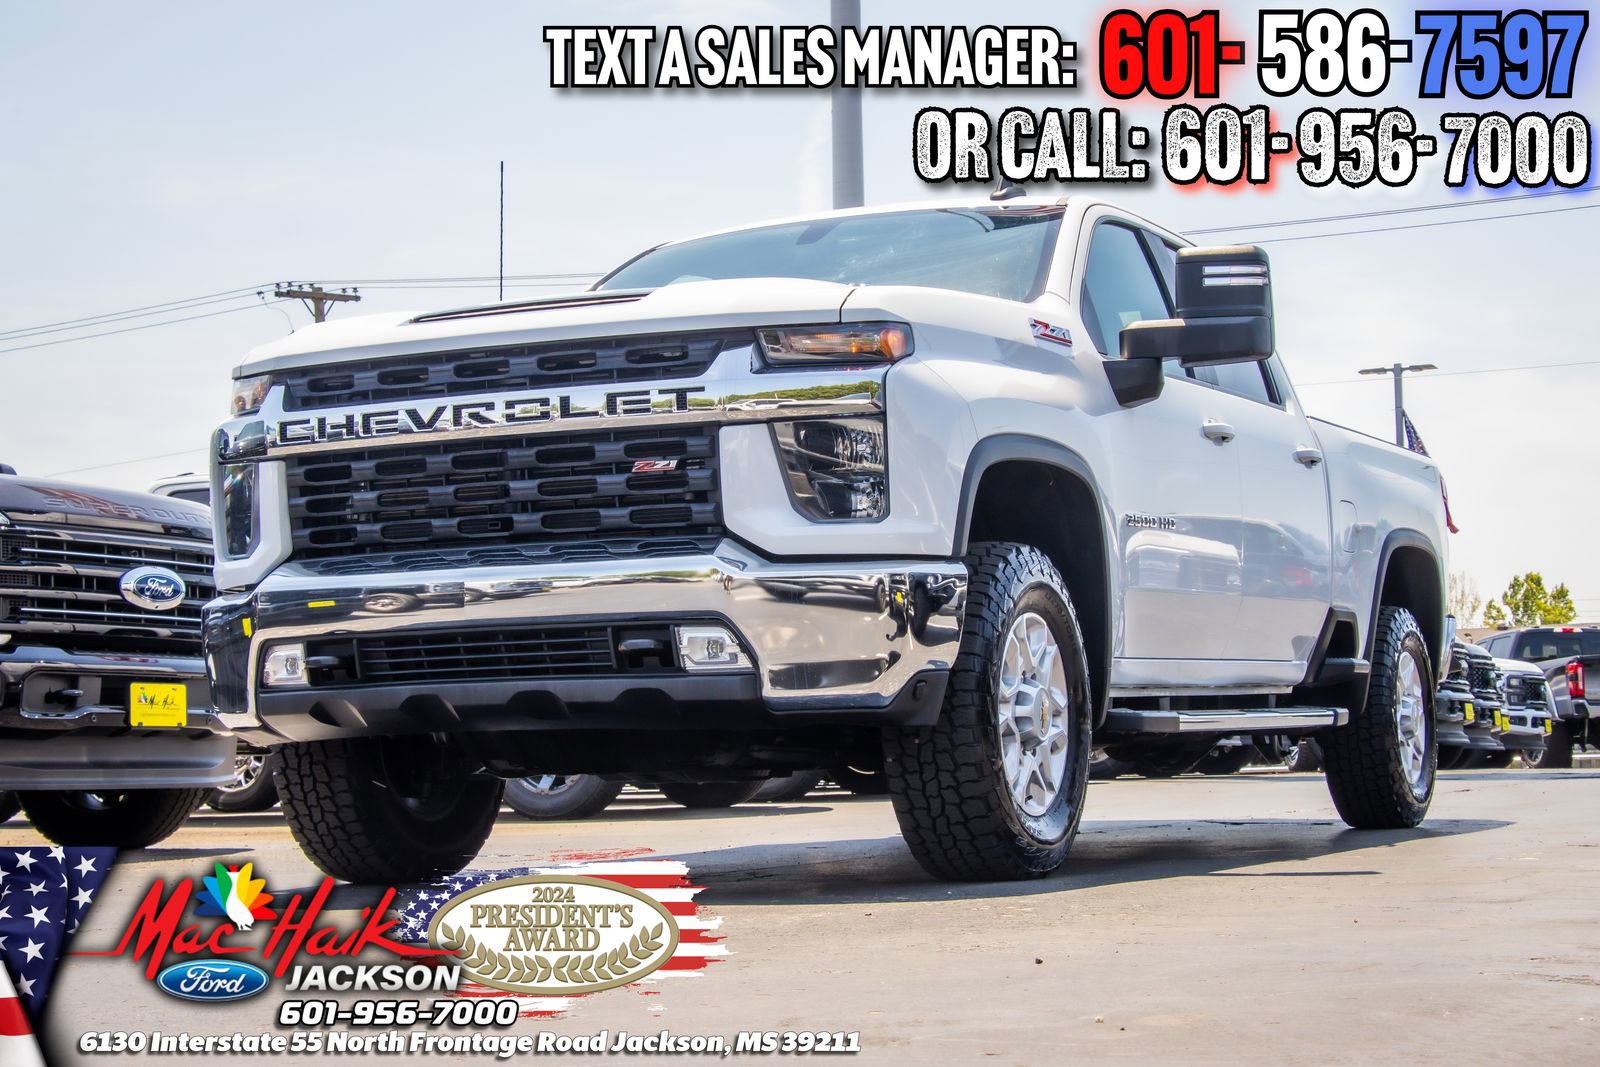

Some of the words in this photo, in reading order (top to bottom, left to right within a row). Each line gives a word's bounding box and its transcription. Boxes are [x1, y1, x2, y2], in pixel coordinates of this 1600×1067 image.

[277, 386, 706, 445] CHEVROLET
[44, 496, 149, 521] SUPER
[1125, 513, 1157, 528] 2500
[1158, 516, 1176, 530] HD
[144, 577, 176, 598] Ford
